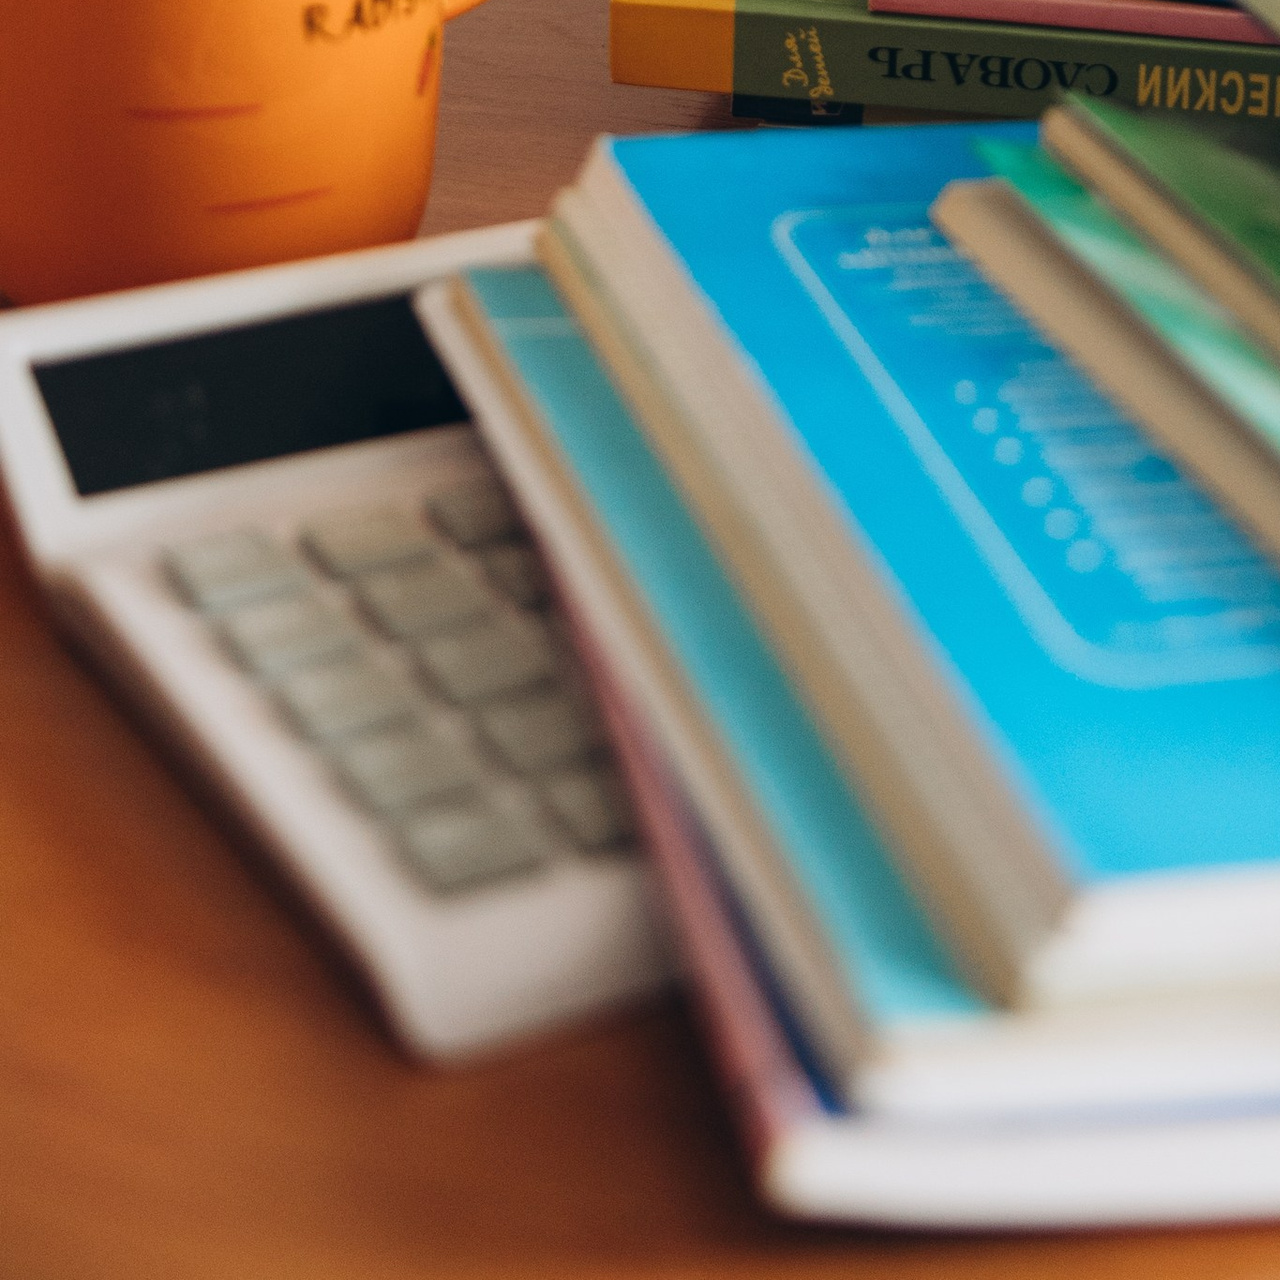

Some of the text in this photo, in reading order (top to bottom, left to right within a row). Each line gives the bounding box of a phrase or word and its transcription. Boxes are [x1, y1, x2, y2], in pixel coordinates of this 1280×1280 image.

[781, 31, 809, 88] Для
[799, 25, 835, 99] детей
[867, 45, 1120, 98] СЛОВАРЬ
